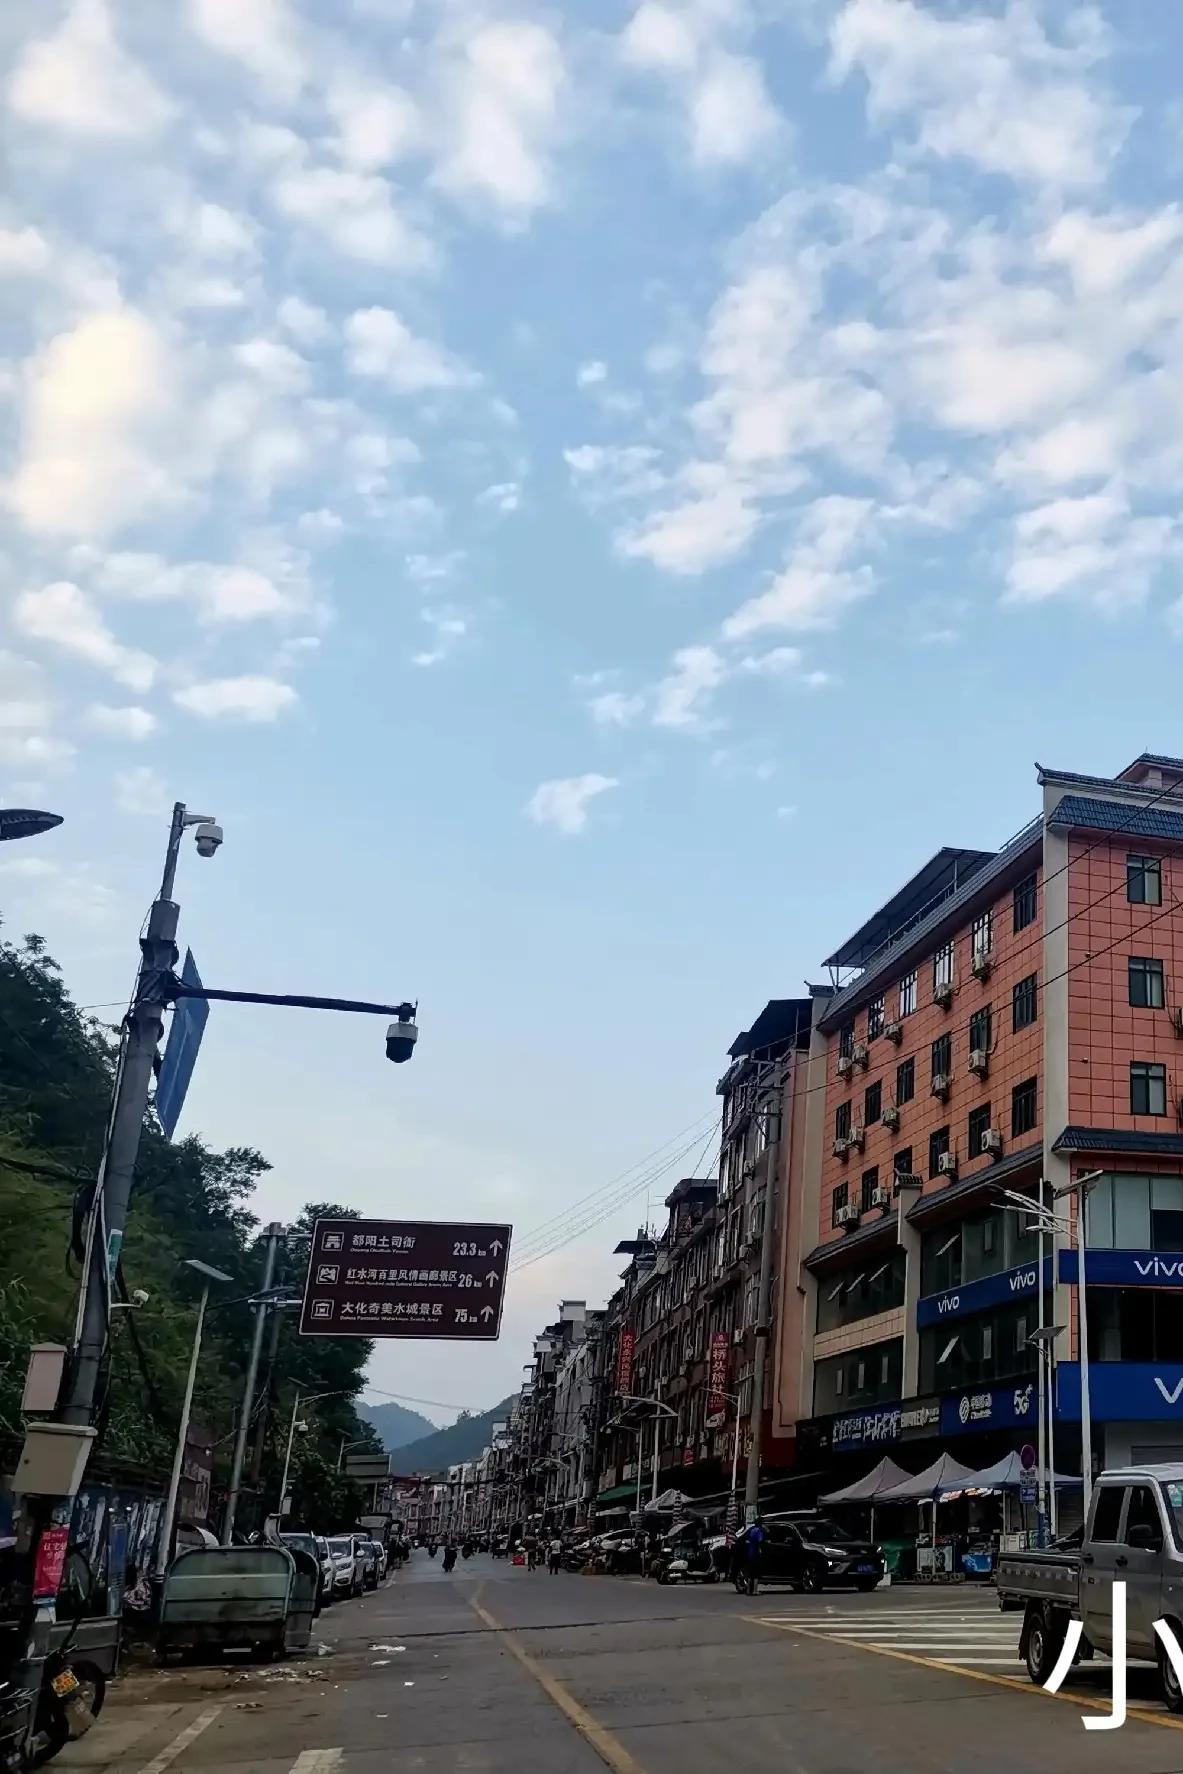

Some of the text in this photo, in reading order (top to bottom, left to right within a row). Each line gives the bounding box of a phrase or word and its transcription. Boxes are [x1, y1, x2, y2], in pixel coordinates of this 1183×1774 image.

[453, 1241, 477, 1256] 23.3
[458, 1273, 473, 1288] 26
[1009, 1270, 1036, 1291] vivo
[341, 1302, 443, 1316] 大化奇美水城景区
[938, 1295, 960, 1314] vivo
[454, 1308, 468, 1323] 75
